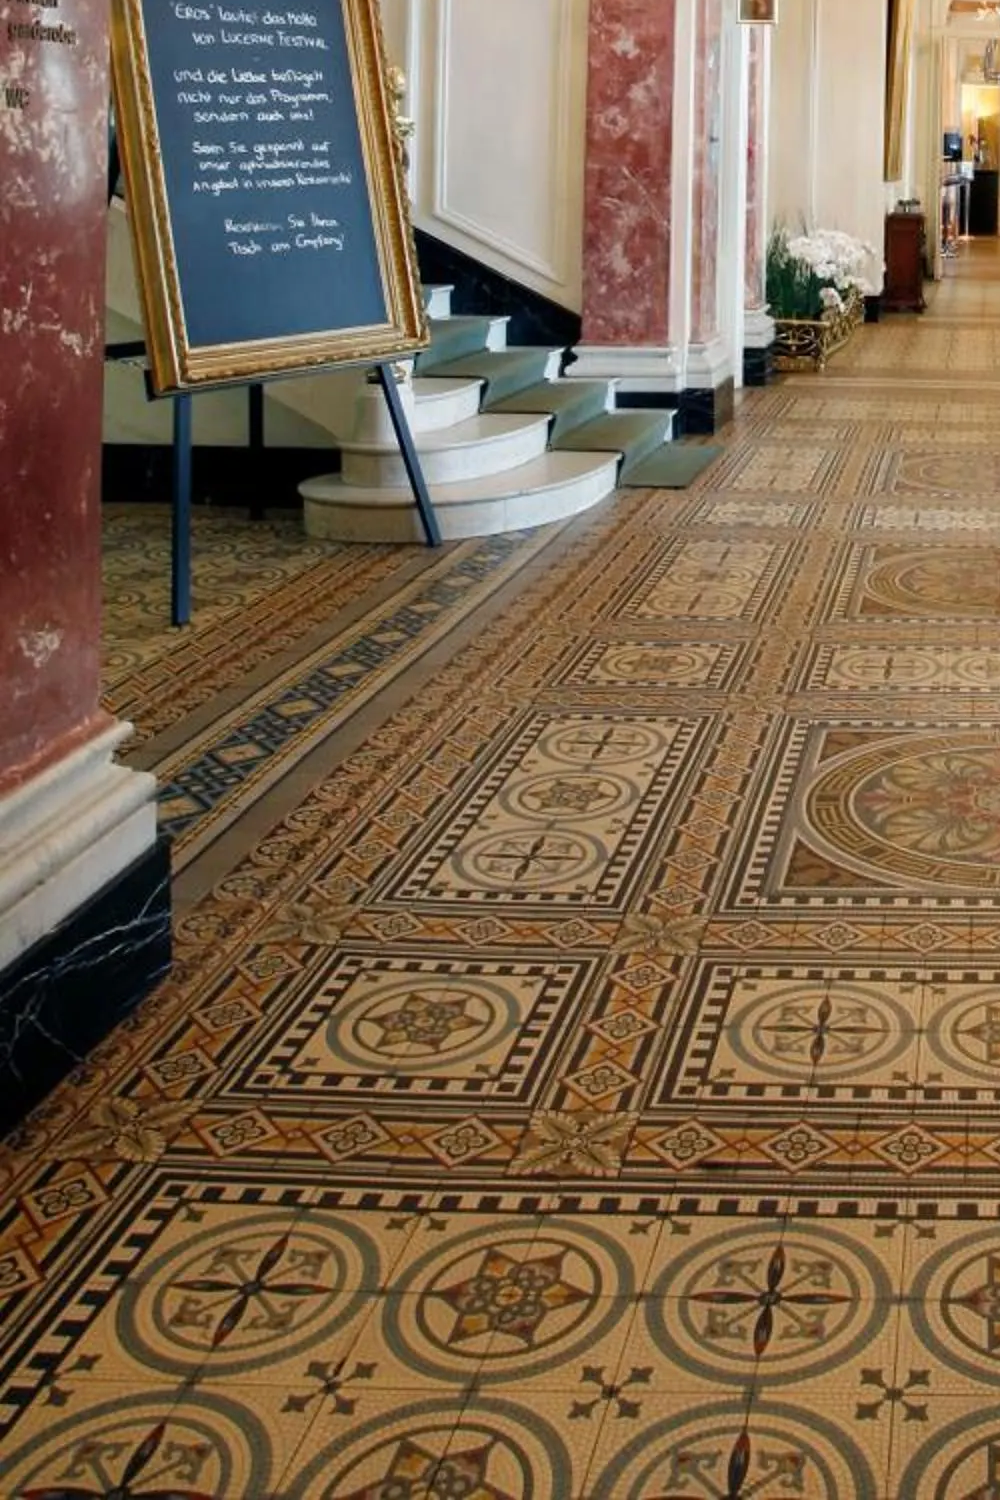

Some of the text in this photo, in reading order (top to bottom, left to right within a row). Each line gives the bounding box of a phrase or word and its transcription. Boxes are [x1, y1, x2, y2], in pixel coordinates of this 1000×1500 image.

[262, 12, 286, 25] das
[221, 29, 275, 46] LUCERNE
[276, 30, 330, 51] FESTIVAL
[206, 70, 228, 84] die
[231, 68, 268, 84] Liebe
[218, 94, 243, 105] nur
[245, 93, 267, 105] das
[257, 109, 285, 121] auch
[230, 141, 249, 154] Sie
[253, 140, 305, 161] gespannt
[311, 141, 332, 153] auf
[243, 179, 254, 190] in
[287, 213, 306, 229] Sie
[227, 239, 263, 256] Tisch
[270, 242, 291, 253] am
